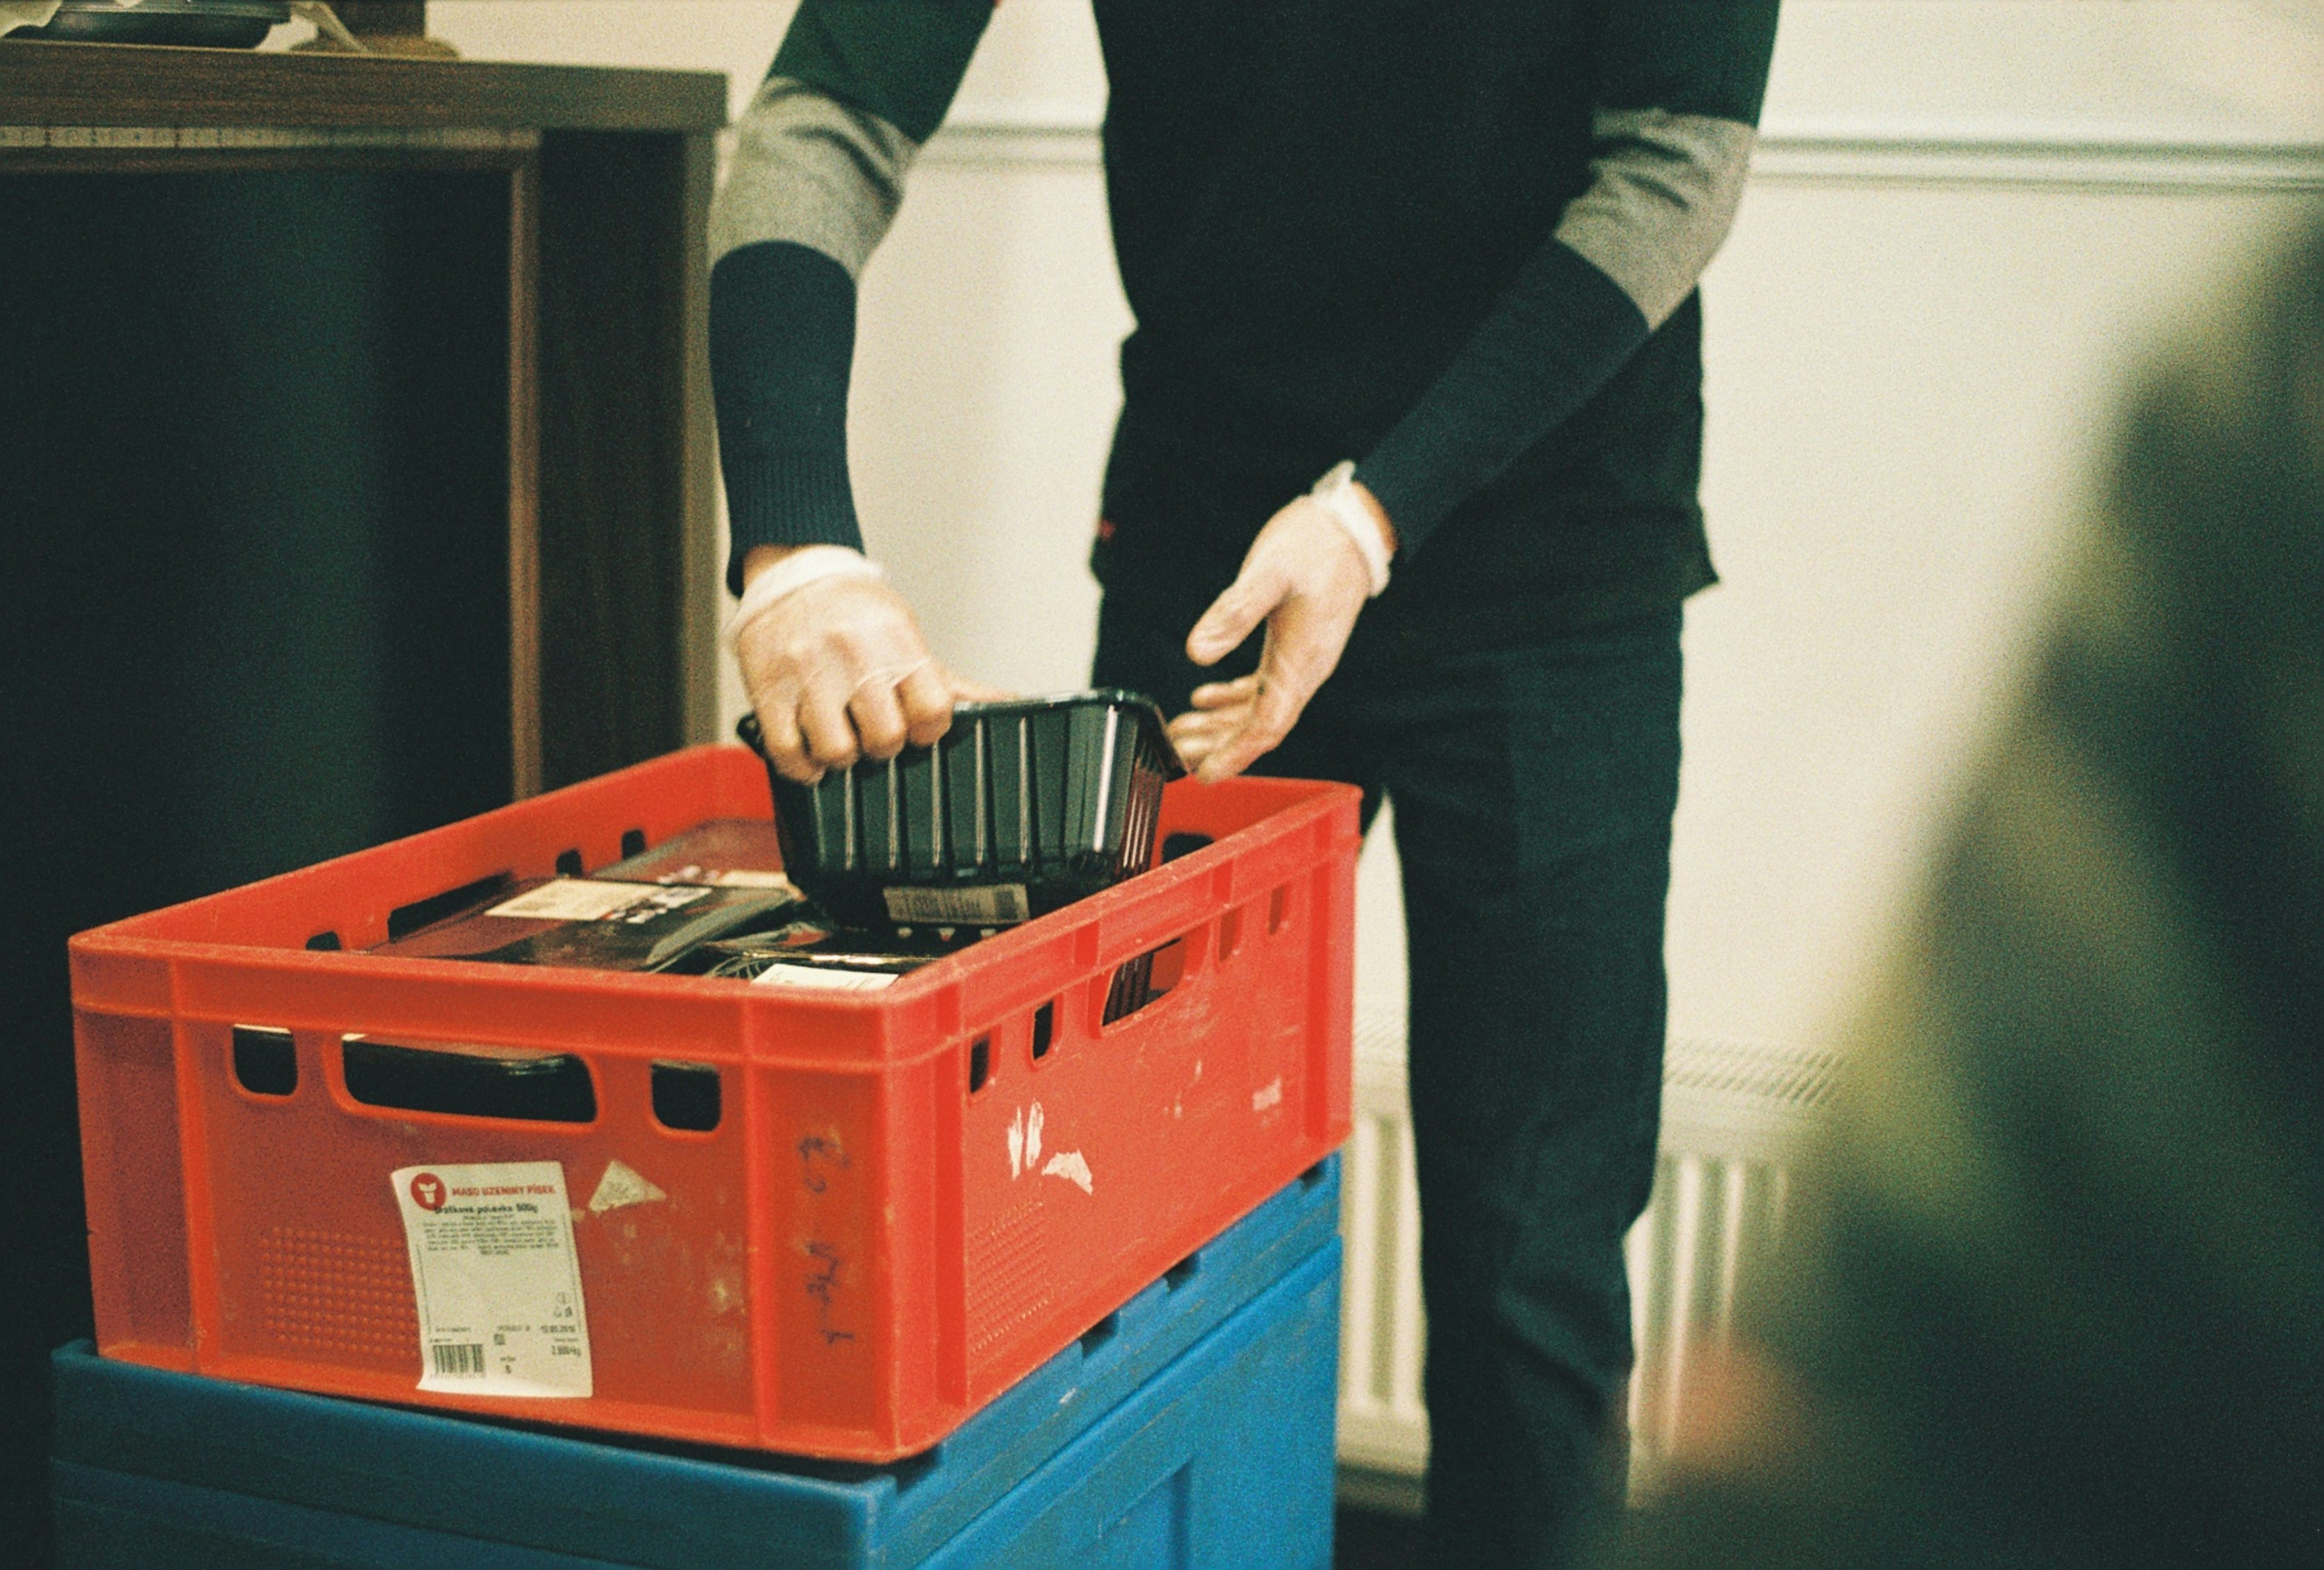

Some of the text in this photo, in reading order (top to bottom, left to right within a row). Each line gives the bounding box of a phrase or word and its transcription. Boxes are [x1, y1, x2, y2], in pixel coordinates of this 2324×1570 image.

[452, 1184, 555, 1196] MASO UZENINY PÍSEK
